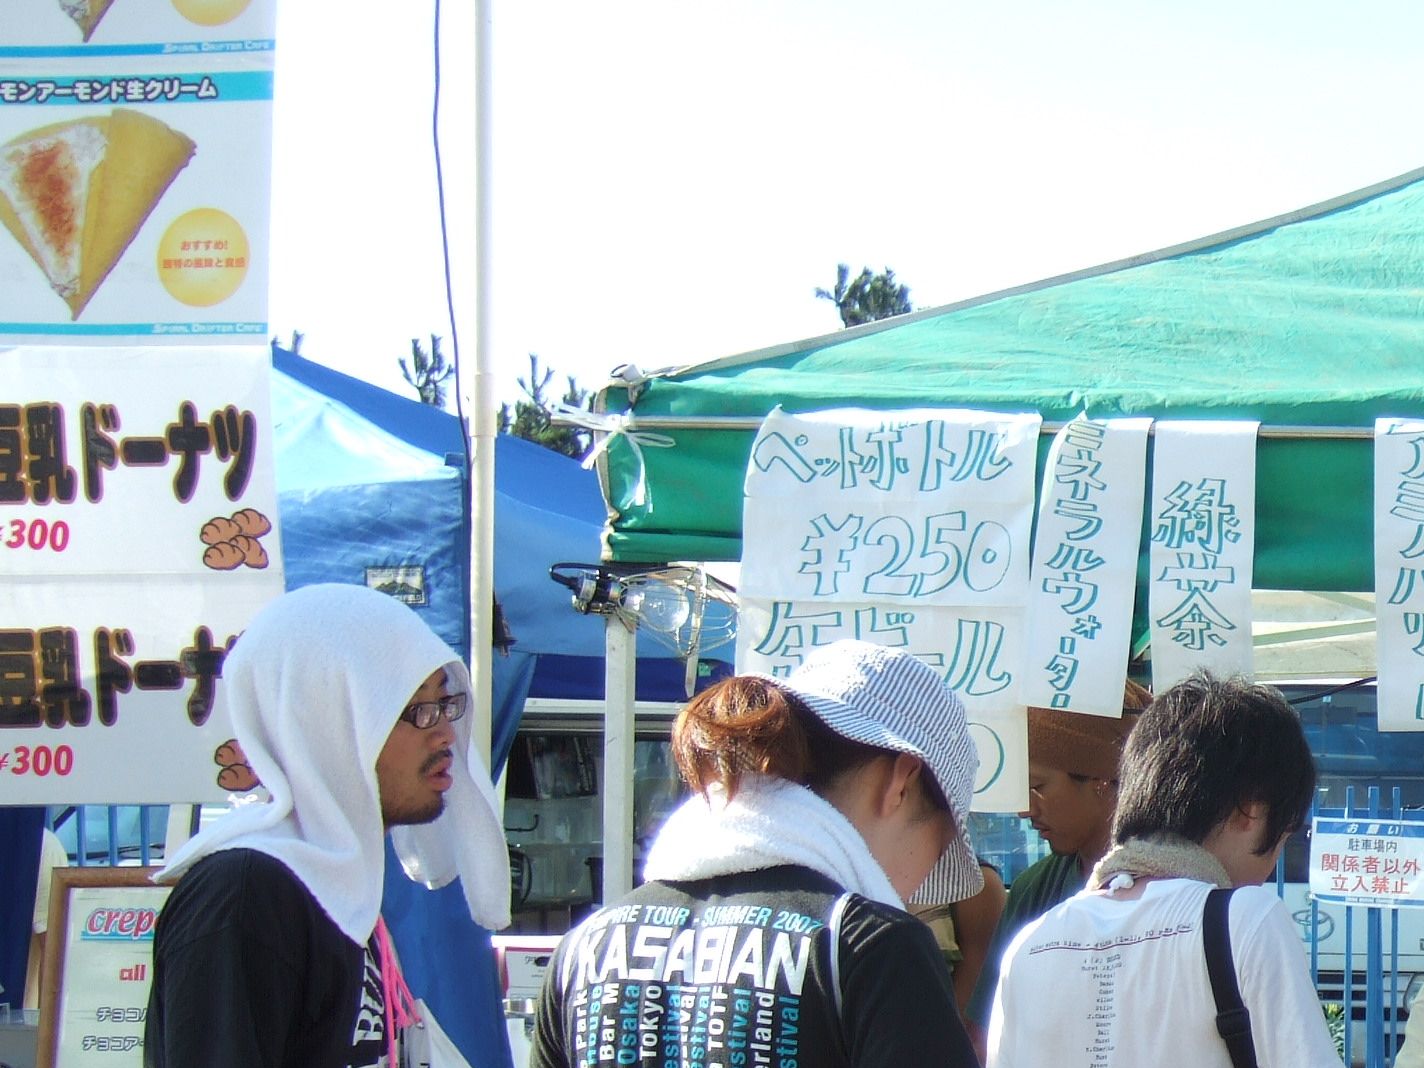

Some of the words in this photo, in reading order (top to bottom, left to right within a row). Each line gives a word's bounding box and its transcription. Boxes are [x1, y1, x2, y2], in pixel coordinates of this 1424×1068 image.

[754, 421, 1012, 493] ペットボトル
[0, 519, 70, 552] 300
[799, 511, 1012, 598] ¥250
[1041, 420, 1108, 709] ミネラルウォーター
[1151, 477, 1241, 652] 緑茶
[0, 625, 245, 728] 豆乳ドーナ
[1321, 853, 1421, 876] 関係者以外
[1347, 838, 1398, 854] 駐車場内
[1330, 874, 1410, 895] 立入禁止
[86, 907, 160, 939] crep
[643, 905, 691, 927] TOUR
[702, 904, 774, 928] SUMMER
[771, 910, 825, 934] 2007
[119, 964, 146, 981] all
[575, 924, 812, 996] KASABIAN
[602, 982, 620, 1004] M
[599, 1014, 616, 1061] Bar
[618, 984, 640, 1065] Osaka
[639, 984, 664, 1061] Tokyo
[707, 984, 729, 1052] TOTF
[82, 1035, 145, 1052] チョコア
